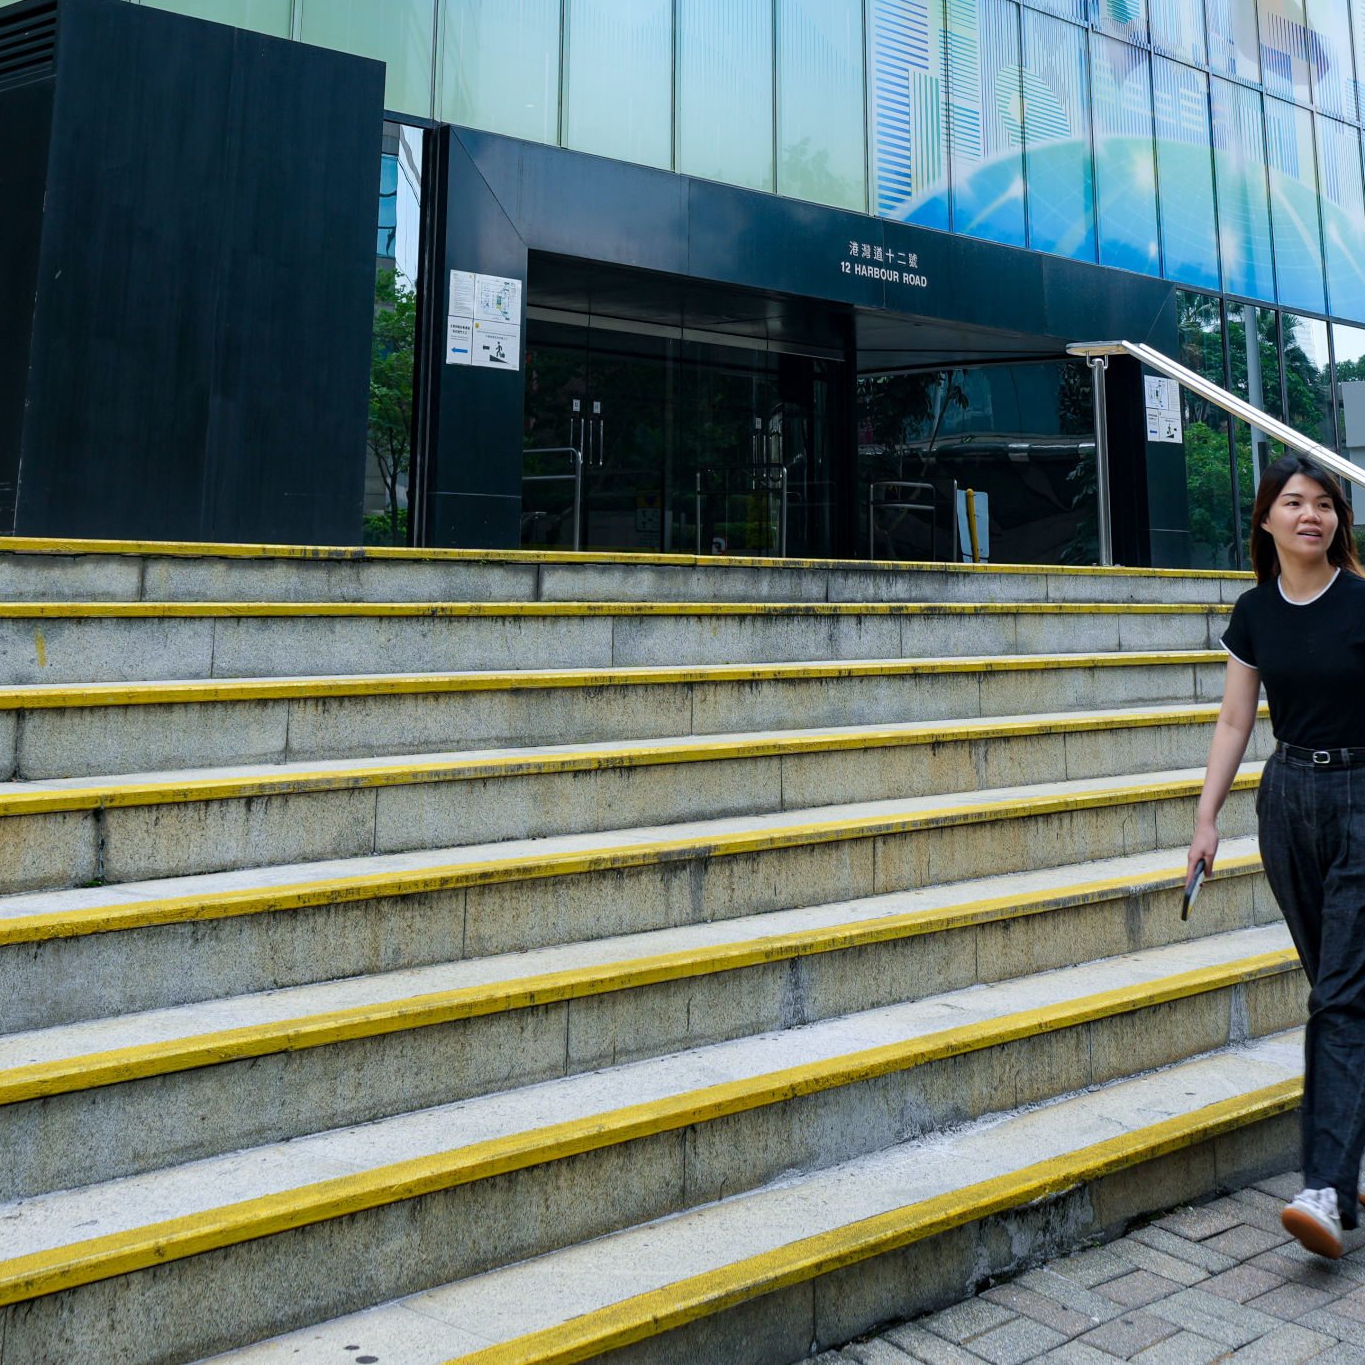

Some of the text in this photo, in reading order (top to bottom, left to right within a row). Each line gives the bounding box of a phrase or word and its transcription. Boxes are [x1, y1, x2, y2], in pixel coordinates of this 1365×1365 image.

[849, 241, 918, 268] 港灣道十二號
[840, 261, 927, 288] 12 HARBOUR ROAD
